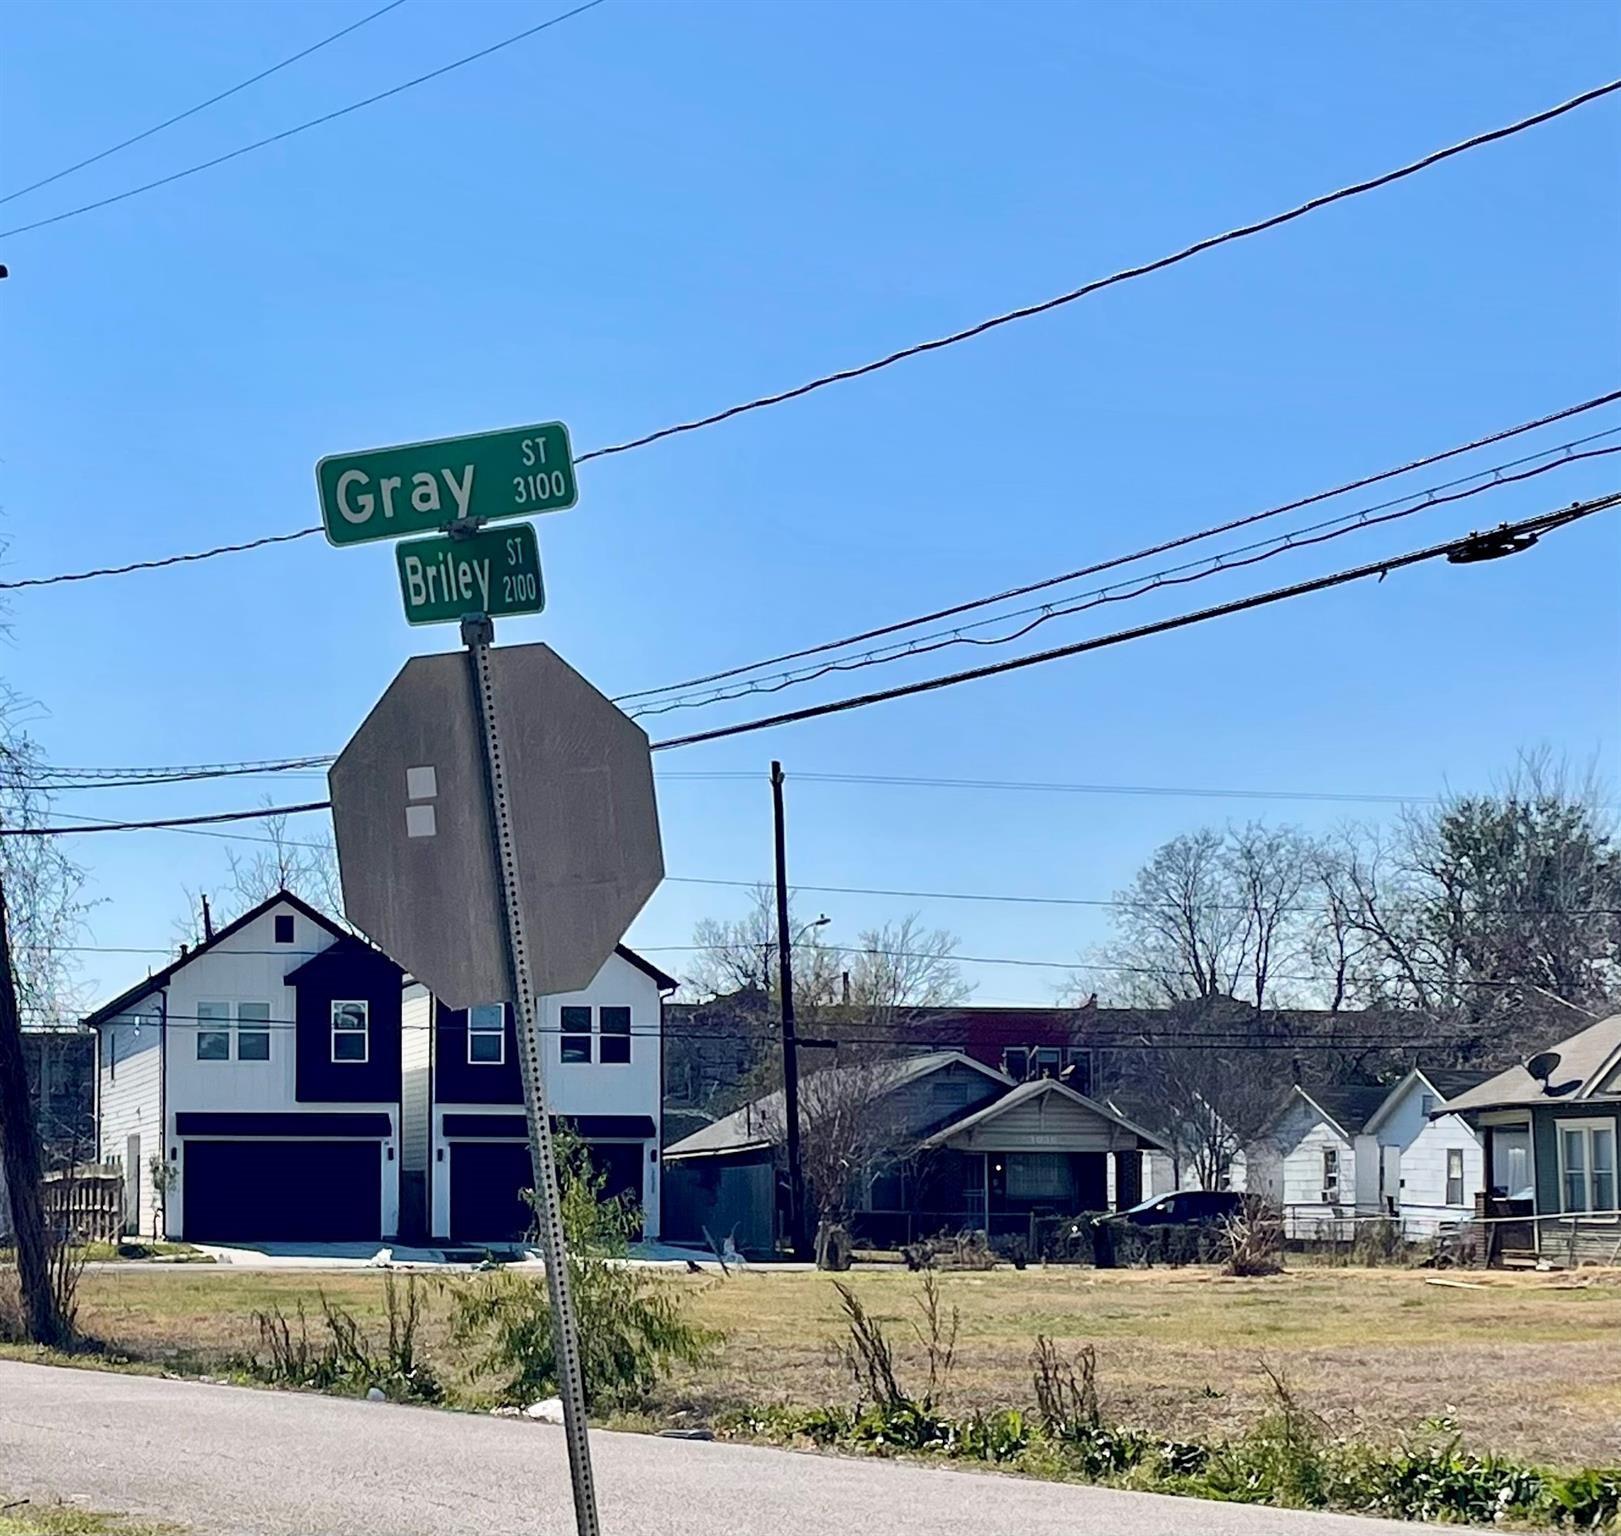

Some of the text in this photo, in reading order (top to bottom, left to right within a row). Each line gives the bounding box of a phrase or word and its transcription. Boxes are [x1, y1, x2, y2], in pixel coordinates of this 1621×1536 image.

[521, 437, 547, 466] ST
[337, 465, 474, 523] Gray
[513, 471, 565, 503] 3100
[507, 537, 522, 565] ST
[405, 553, 490, 611] Briley
[503, 574, 536, 603] 2100
